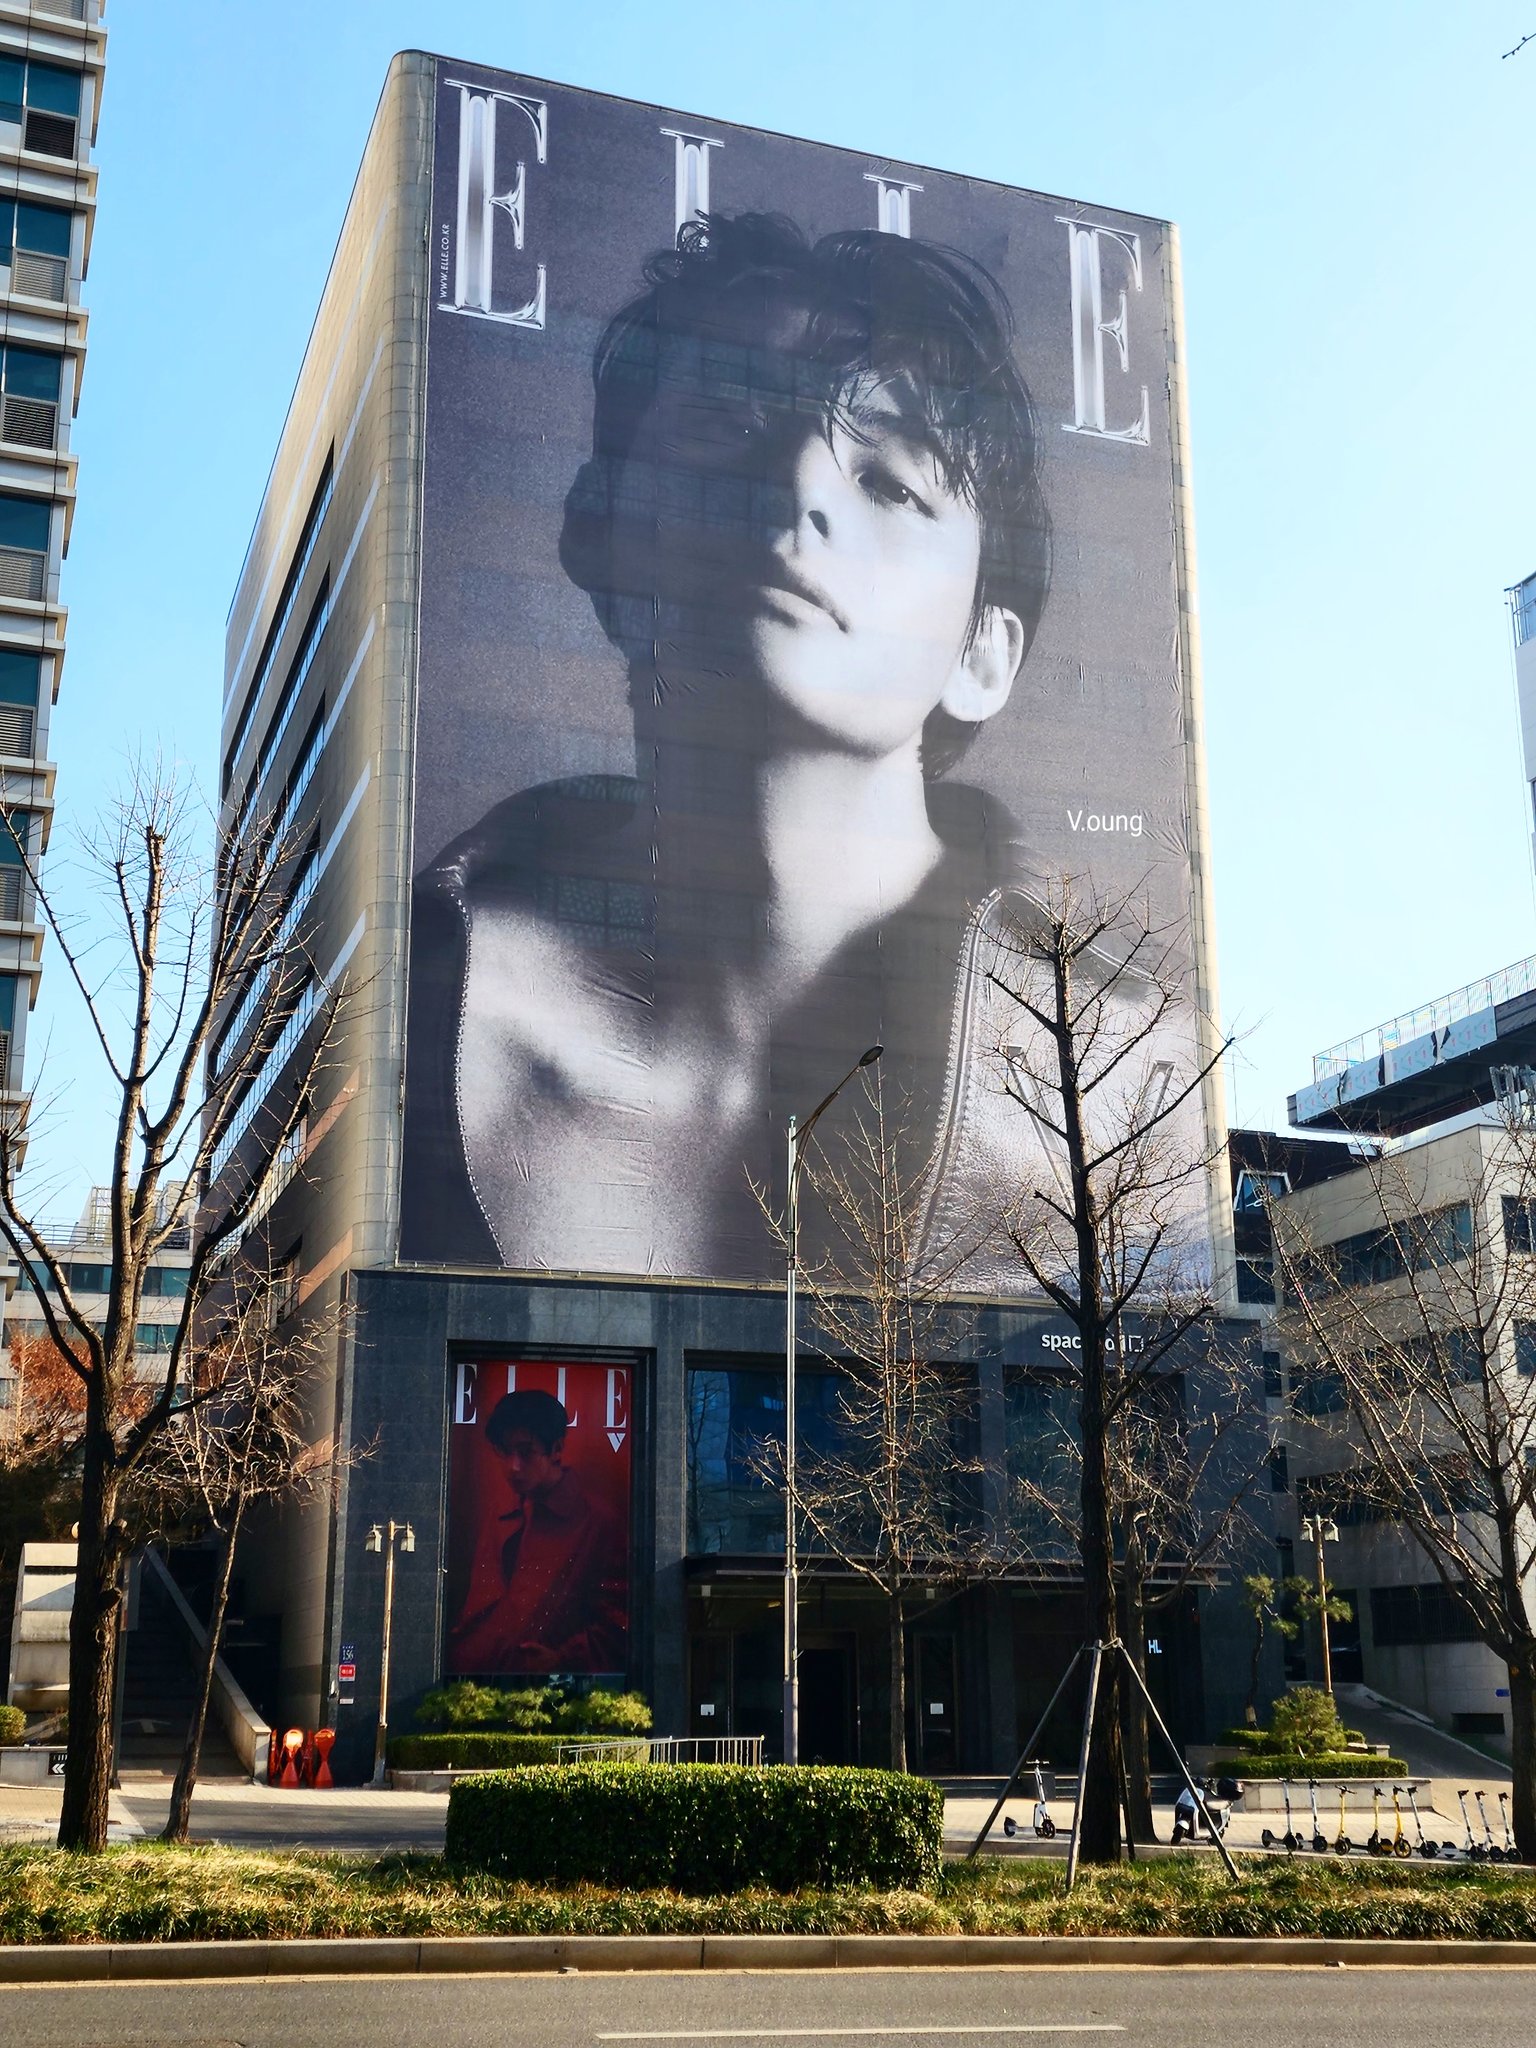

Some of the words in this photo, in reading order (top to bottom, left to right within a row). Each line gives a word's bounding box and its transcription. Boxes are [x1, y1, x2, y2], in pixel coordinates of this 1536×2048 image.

[437, 78, 1149, 446] EE
[440, 223, 450, 298] WWW.ELLE.CO.KR
[1067, 809, 1143, 837] V.oung
[1041, 1334, 1083, 1352] spac
